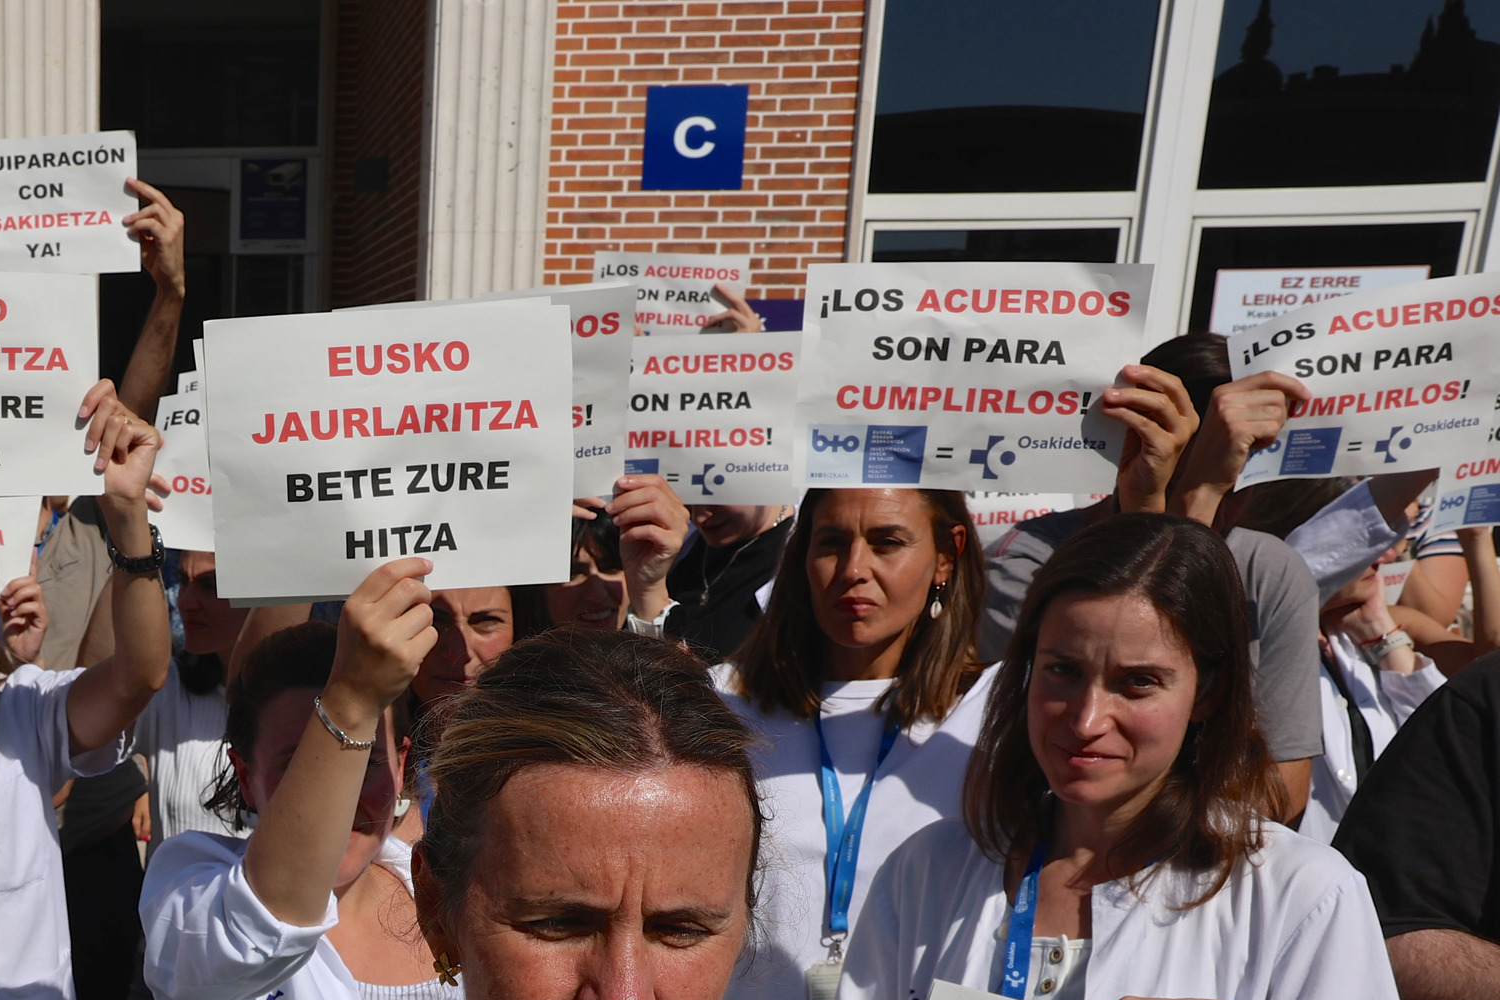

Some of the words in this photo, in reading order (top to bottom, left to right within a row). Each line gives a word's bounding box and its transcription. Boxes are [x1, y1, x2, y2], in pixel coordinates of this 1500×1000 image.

[673, 115, 716, 159] C
[18, 184, 62, 200] CON
[26, 242, 60, 258] YA!
[601, 265, 639, 278] ¡LOS
[645, 265, 740, 281] ACUERDOS
[1281, 277, 1304, 288] EZ
[1310, 276, 1361, 288] ERRE
[637, 289, 659, 300] ON
[665, 290, 711, 303] PARA
[820, 288, 904, 318] ¡LOS
[918, 288, 1130, 316] ACUERDOS
[1242, 294, 1298, 306] LEIHO
[872, 336, 950, 362] SON
[964, 338, 1066, 364] PARA
[1244, 323, 1316, 365] ¡LOS
[328, 340, 470, 376] EUSKO
[644, 352, 794, 374] ACUERDOS
[1295, 352, 1361, 378] SON
[1374, 342, 1453, 370] PARA
[628, 394, 669, 412] ON
[680, 391, 752, 411] PARA
[836, 385, 1092, 416] CUMPLIRLOS!
[1288, 380, 1470, 418] UMPLIRLOS!
[252, 400, 538, 444] JAURLARITZA
[1414, 416, 1480, 434] Osakidetza
[626, 428, 772, 449] MPLIRLOS!
[1018, 436, 1106, 451] Osakidetza
[725, 463, 789, 473] Osakidetza
[286, 468, 394, 502] BETE
[406, 460, 510, 494] ZURE
[346, 522, 458, 560] HITZA
